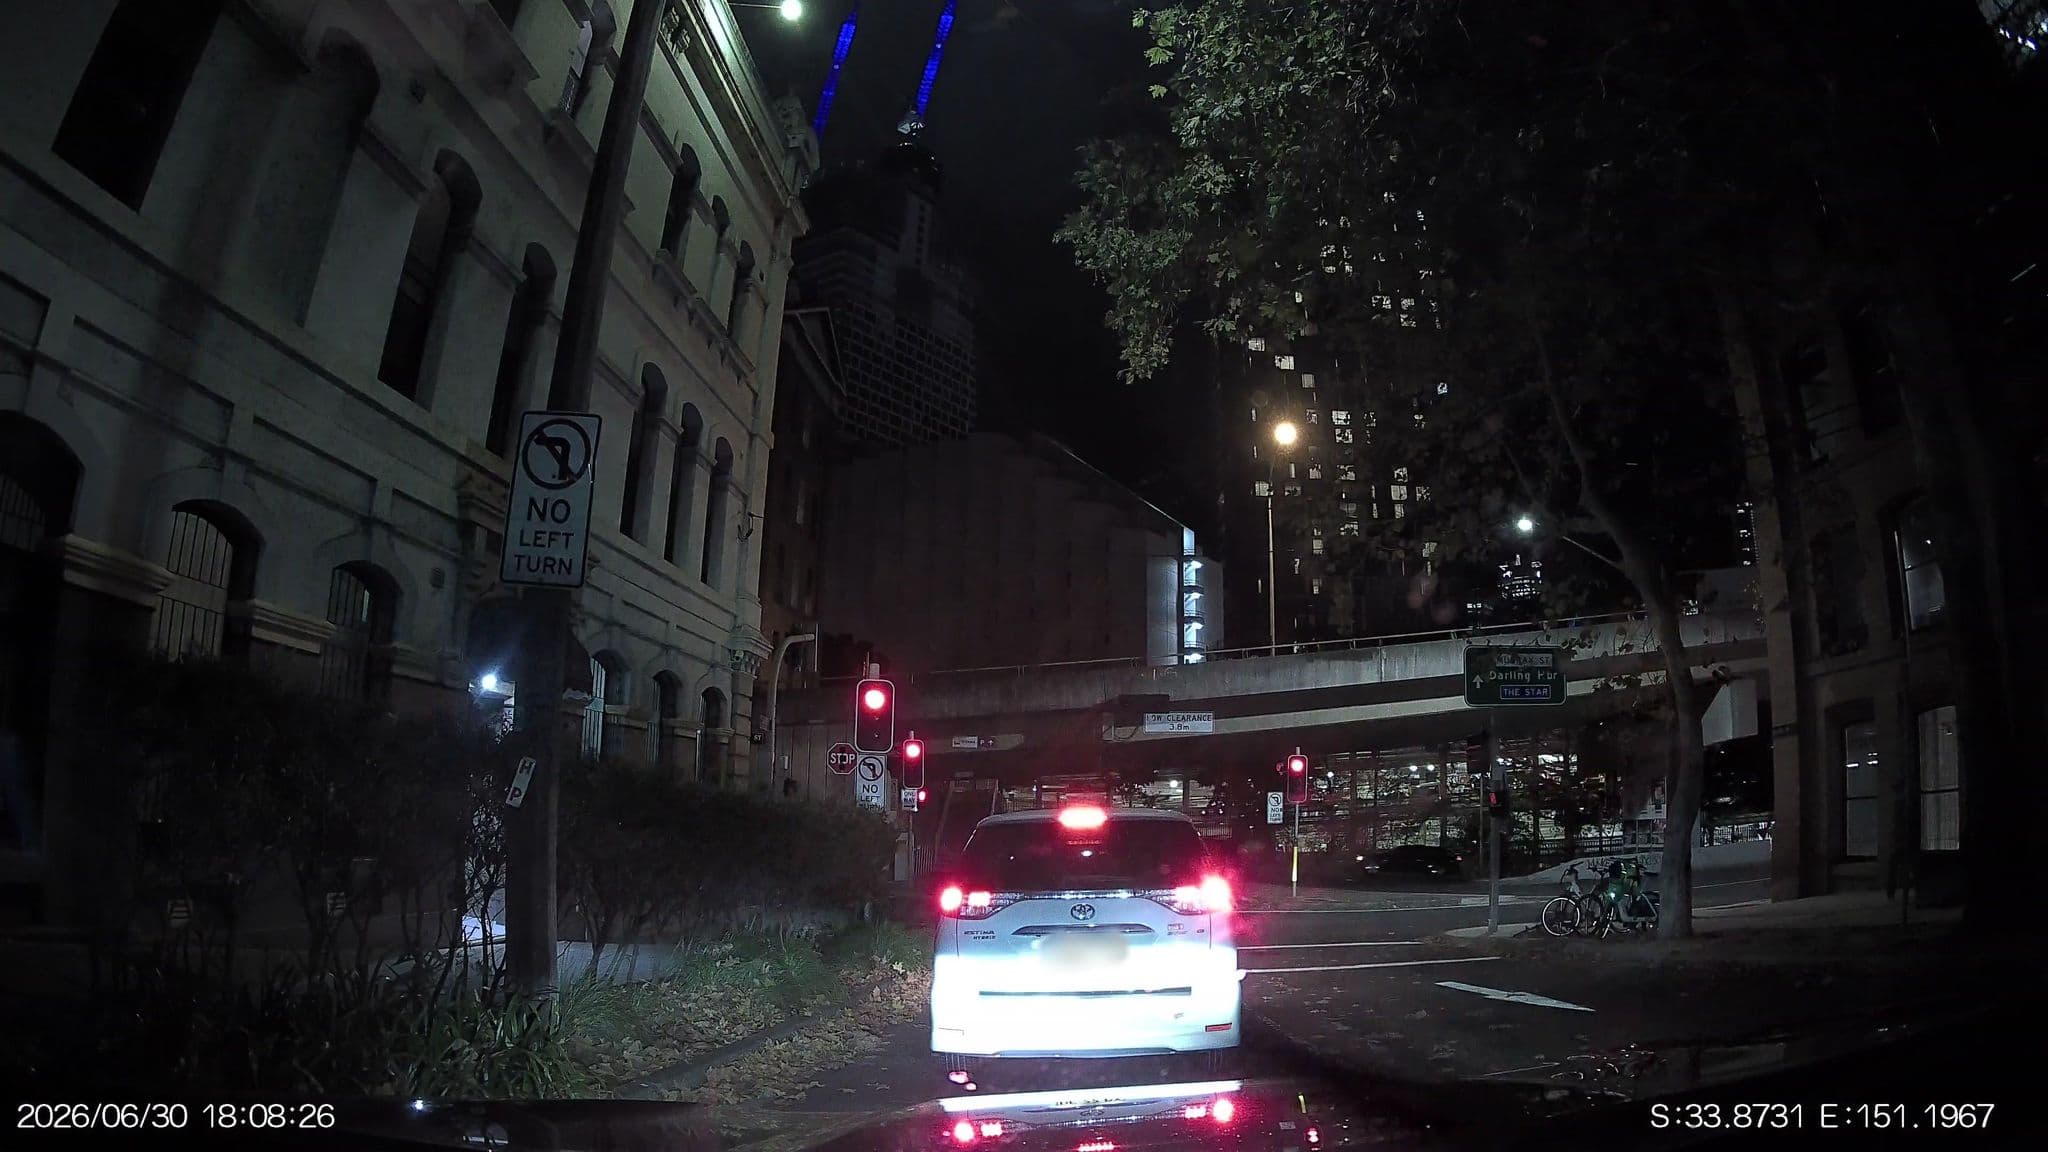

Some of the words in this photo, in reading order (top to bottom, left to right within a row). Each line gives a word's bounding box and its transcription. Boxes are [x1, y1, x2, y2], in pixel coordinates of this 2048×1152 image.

[526, 497, 571, 524] NO
[519, 529, 574, 549] LEFT
[513, 554, 573, 576] TURN
[1488, 670, 1531, 683] Darling
[1503, 688, 1521, 696] THE
[1524, 687, 1549, 696] STAR
[1166, 714, 1212, 722] CLEARANCE
[1169, 723, 1190, 731] 3.8m
[830, 752, 856, 765] STOP
[862, 784, 878, 794] NO
